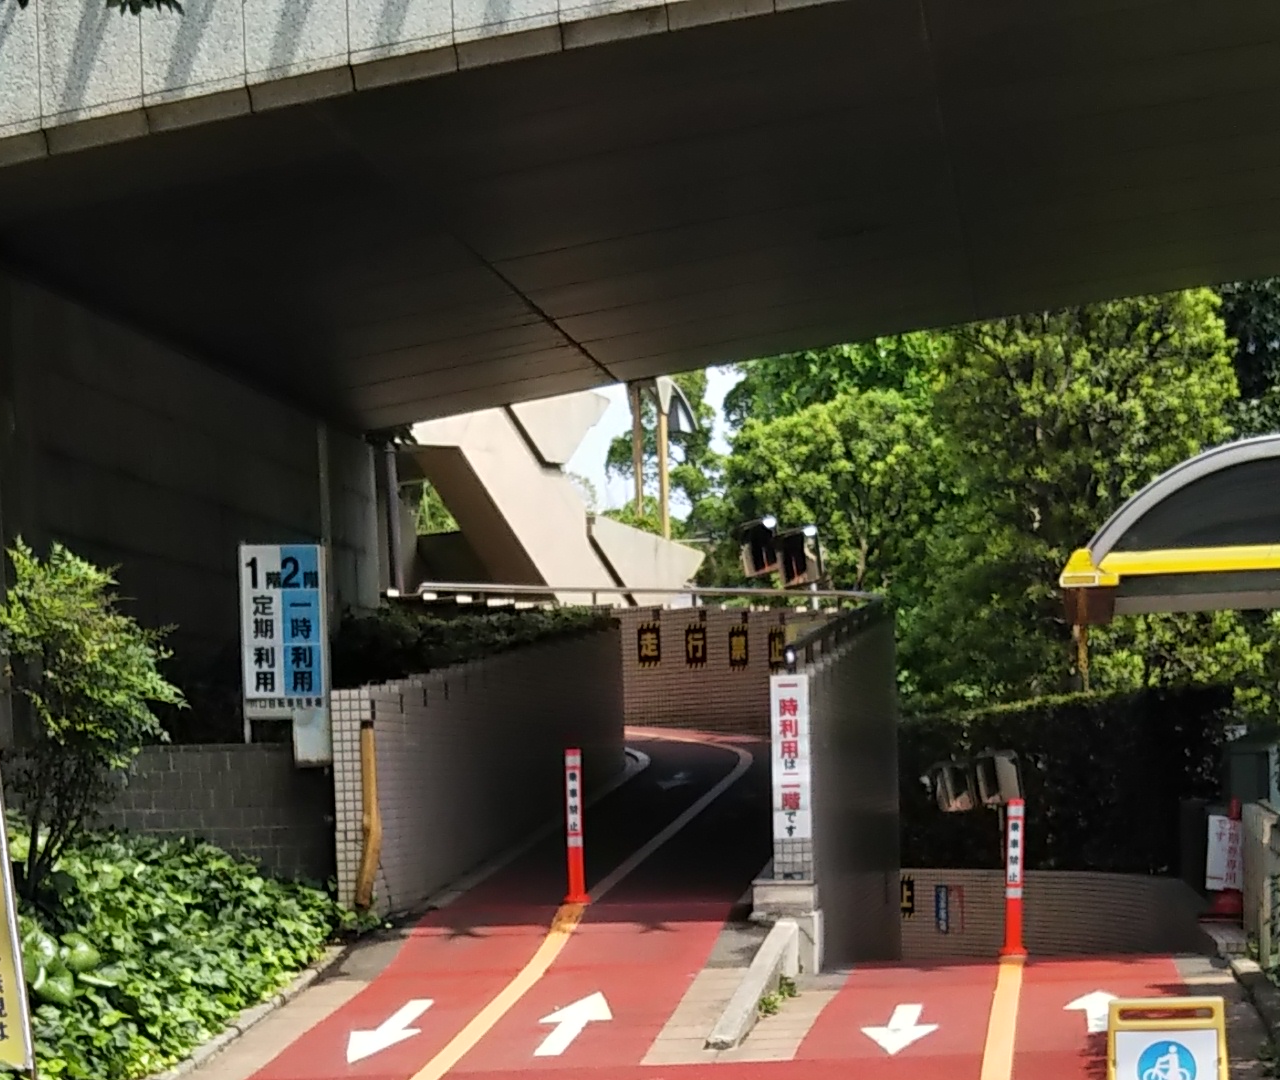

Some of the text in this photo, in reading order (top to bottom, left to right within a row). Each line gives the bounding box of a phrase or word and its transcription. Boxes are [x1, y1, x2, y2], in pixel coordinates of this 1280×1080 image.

[252, 595, 275, 693] 定期利用
[289, 602, 313, 692] 一時利用
[1009, 821, 1019, 883] 乗車禁止
